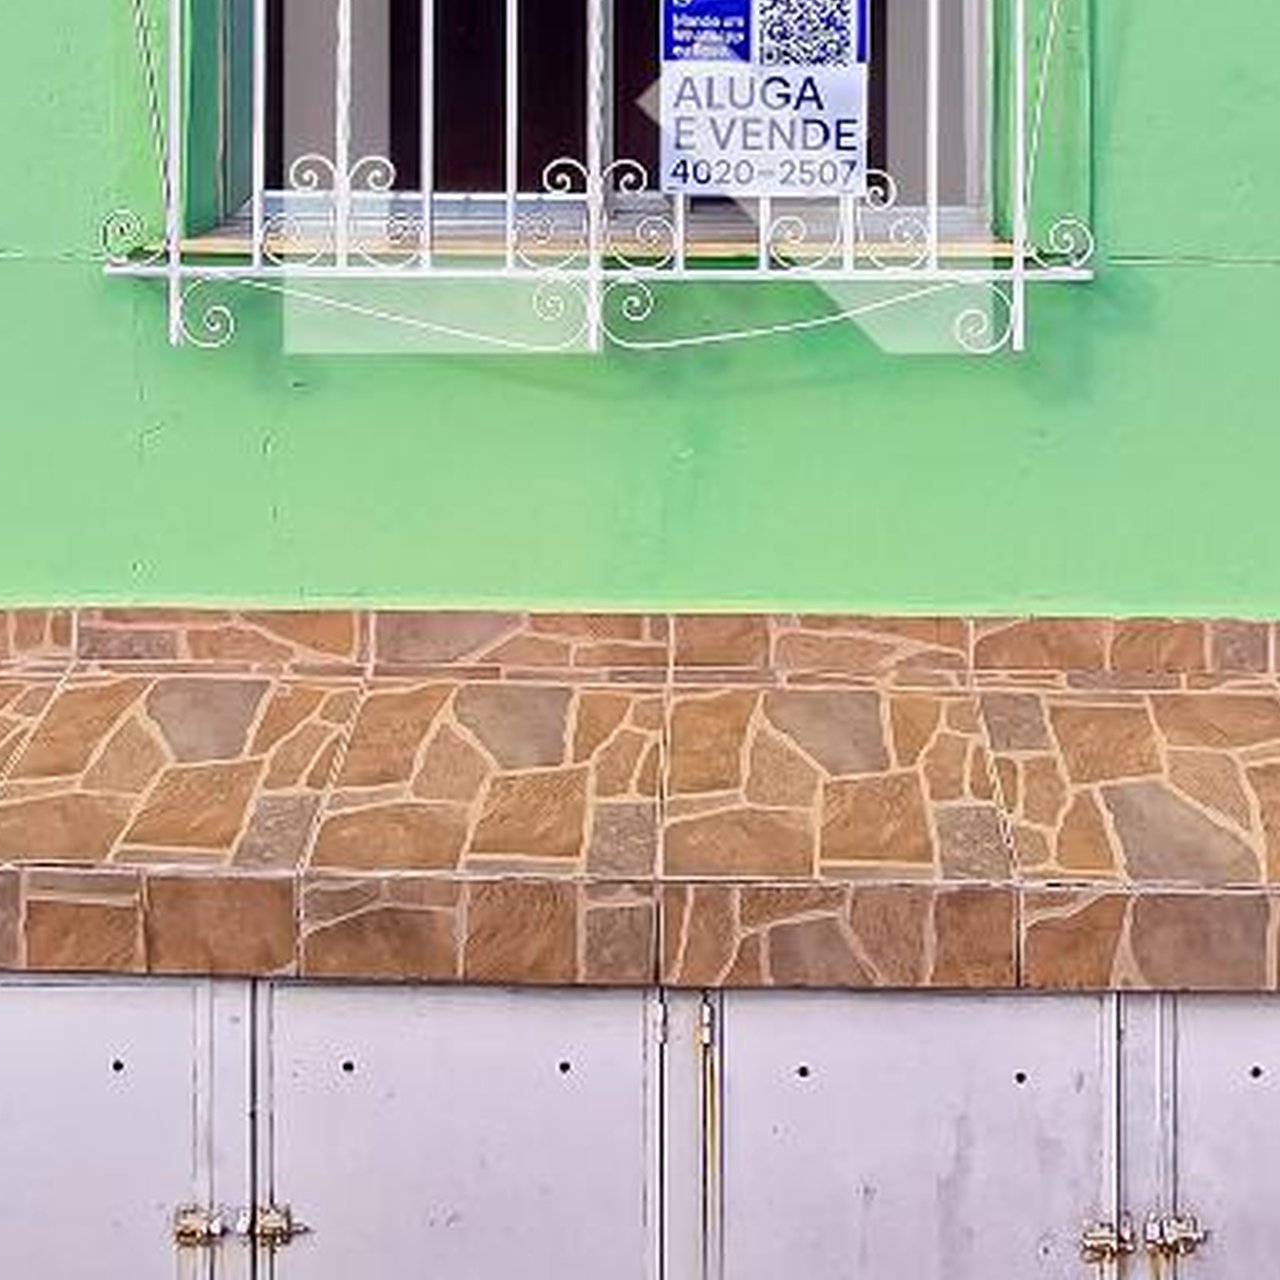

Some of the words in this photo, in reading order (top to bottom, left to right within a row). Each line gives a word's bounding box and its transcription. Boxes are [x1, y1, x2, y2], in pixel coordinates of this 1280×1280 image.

[673, 76, 824, 110] ALUGA
[674, 119, 695, 151] E
[710, 119, 858, 151] VENDE
[670, 159, 858, 185] 4020-2507
